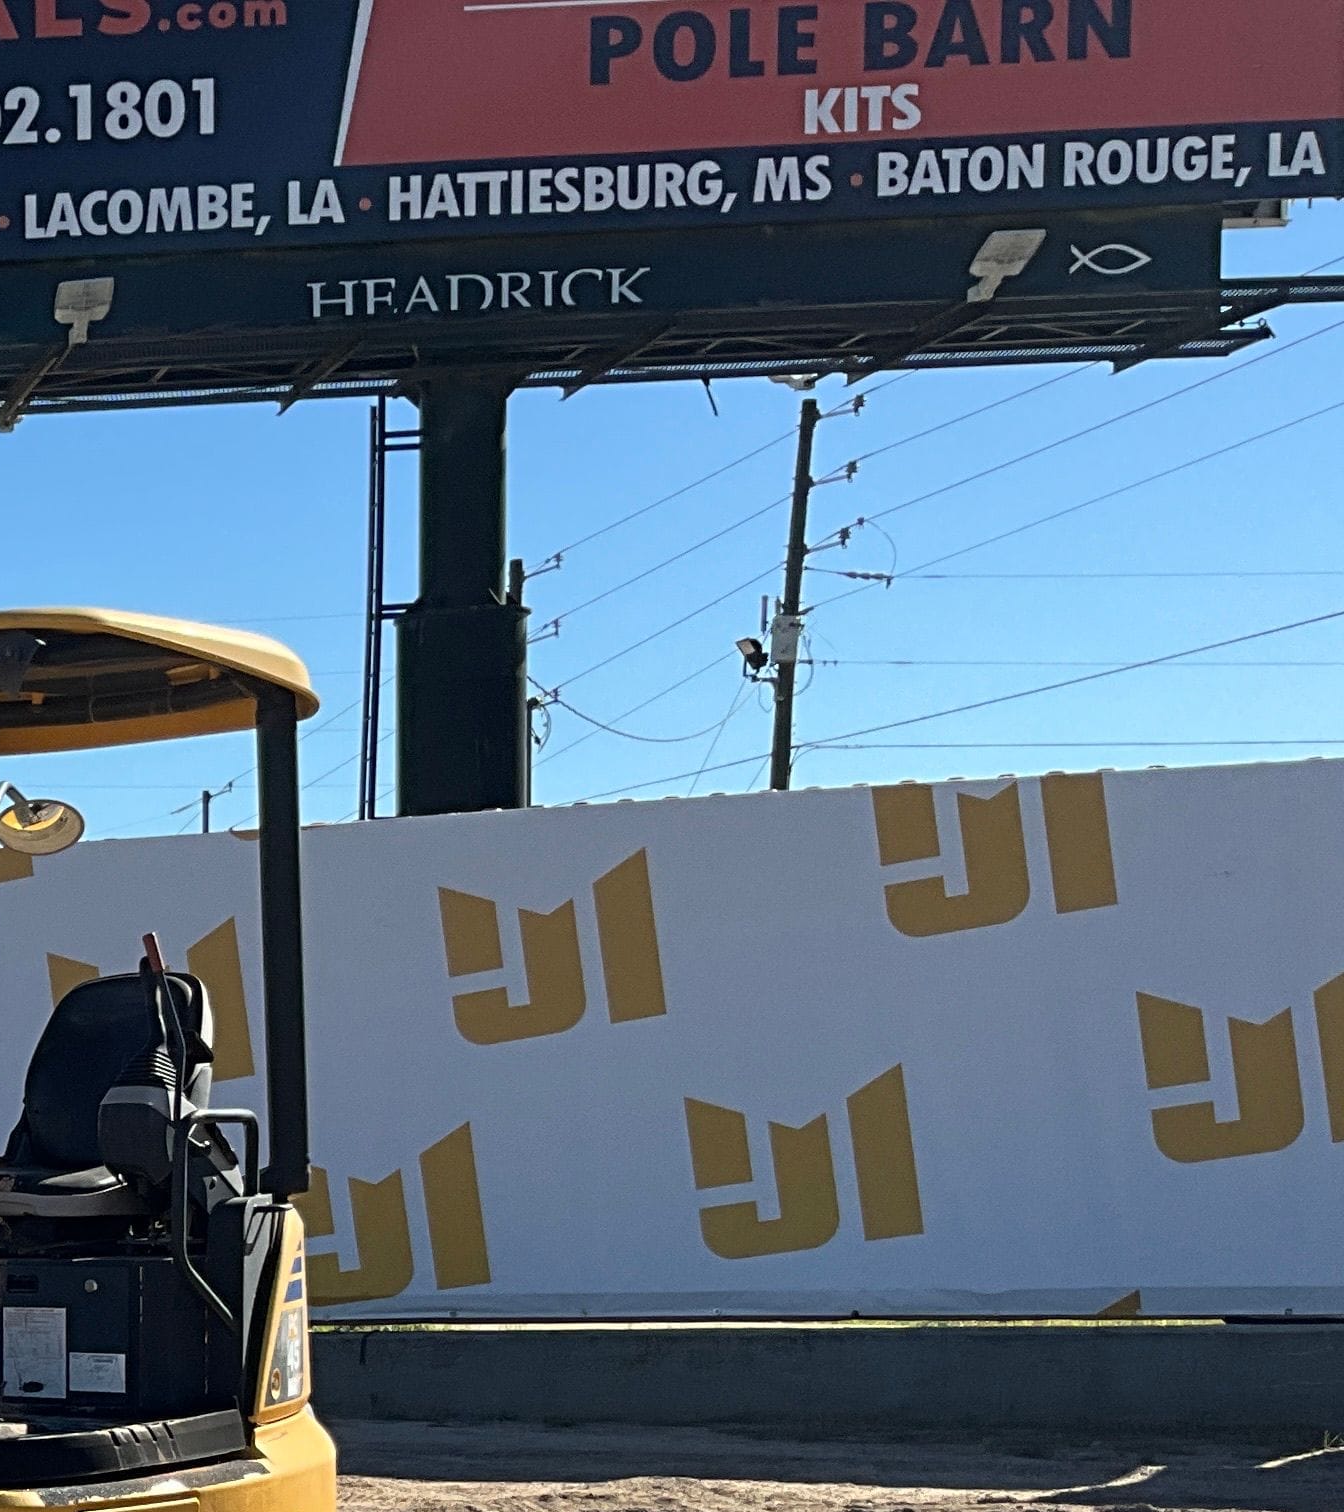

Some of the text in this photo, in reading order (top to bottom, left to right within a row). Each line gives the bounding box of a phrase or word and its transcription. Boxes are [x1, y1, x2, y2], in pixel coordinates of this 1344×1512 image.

[589, 0, 1133, 86] POLE BARN
[803, 83, 922, 135] KITS
[23, 183, 272, 240] LACOMBE,
[287, 179, 345, 226] LA
[388, 160, 738, 222] HATTIESBURG,
[753, 155, 832, 203] MS
[876, 143, 1045, 197] BATON
[1063, 134, 1253, 188] ROUGE,
[1268, 131, 1326, 177] LA
[306, 266, 651, 318] HEADRICK
